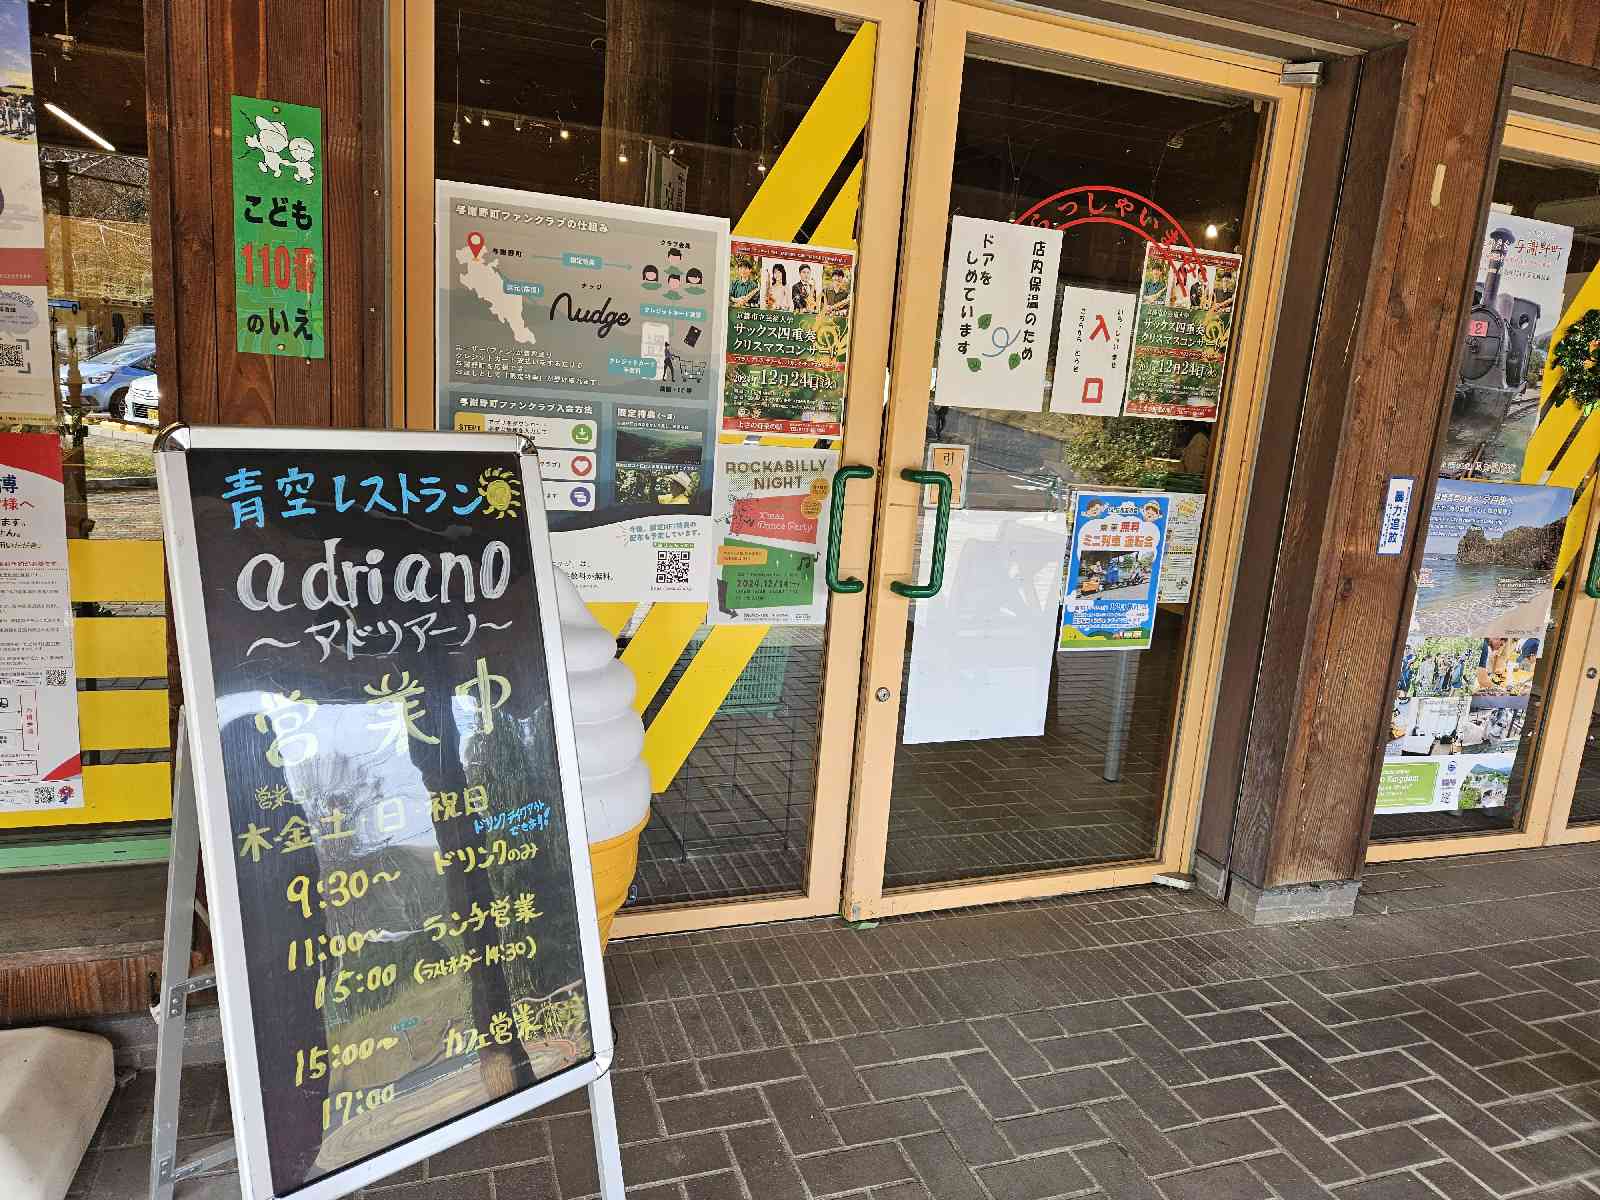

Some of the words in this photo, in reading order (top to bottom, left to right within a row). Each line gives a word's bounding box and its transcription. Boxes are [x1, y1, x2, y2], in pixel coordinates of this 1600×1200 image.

[245, 195, 313, 230] こども
[241, 243, 316, 294] 110番
[979, 232, 996, 286] ドアを
[247, 307, 313, 341] のいえ
[549, 292, 632, 339] Nudge
[956, 250, 979, 356] しめています
[1020, 239, 1047, 362] 店内保温のため
[733, 321, 817, 342] サックス四重奏
[734, 338, 838, 358] クリスマスコンサート
[725, 459, 827, 475] ROCKABILLY
[753, 475, 803, 491] NIGHT
[221, 466, 484, 531] 青空レストラン
[254, 656, 513, 768] 営業中
[432, 839, 539, 877] ドリンクのみ
[423, 892, 544, 942] ランチ営業
[314, 963, 398, 1010] 15:00
[443, 1003, 545, 1058] カフェ営業
[322, 1083, 395, 1131] 17:00
